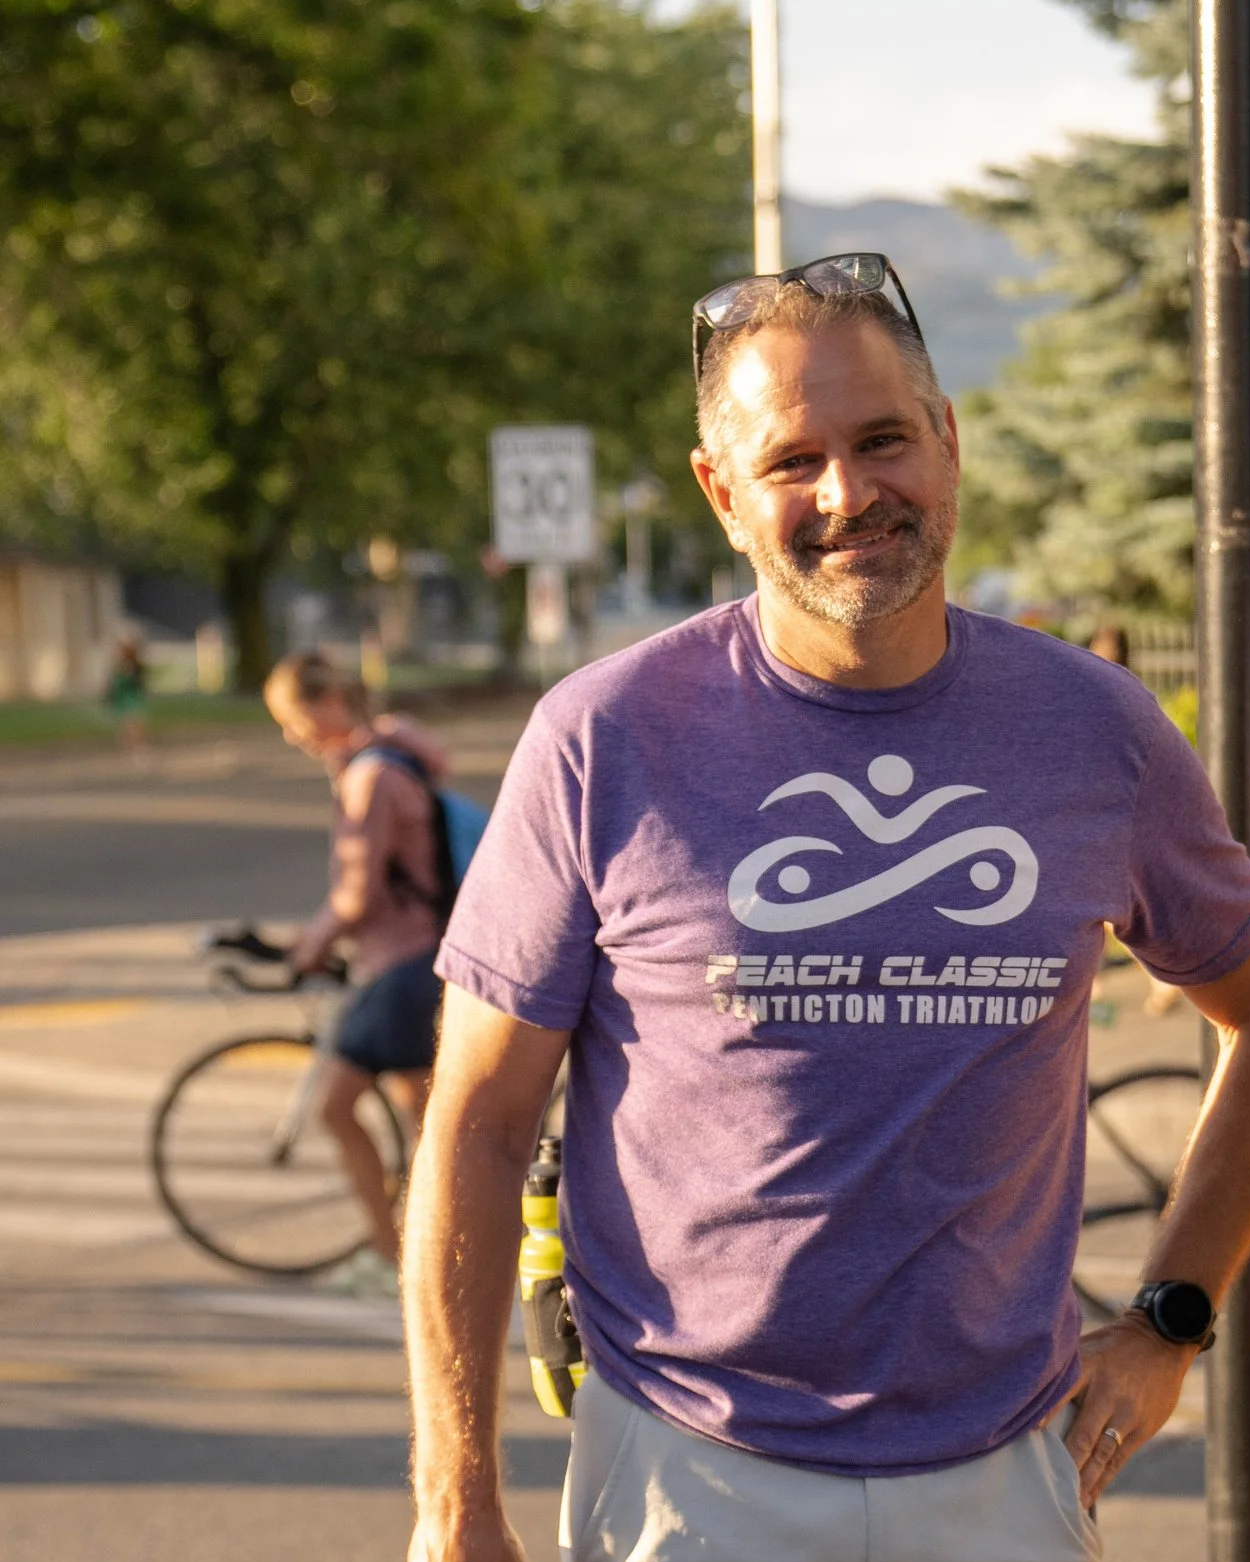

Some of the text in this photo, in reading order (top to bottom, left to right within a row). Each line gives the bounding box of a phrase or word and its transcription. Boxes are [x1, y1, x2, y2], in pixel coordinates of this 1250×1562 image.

[705, 954, 1069, 988] PEACH CLASSIC
[711, 991, 885, 1025] PENTICTON
